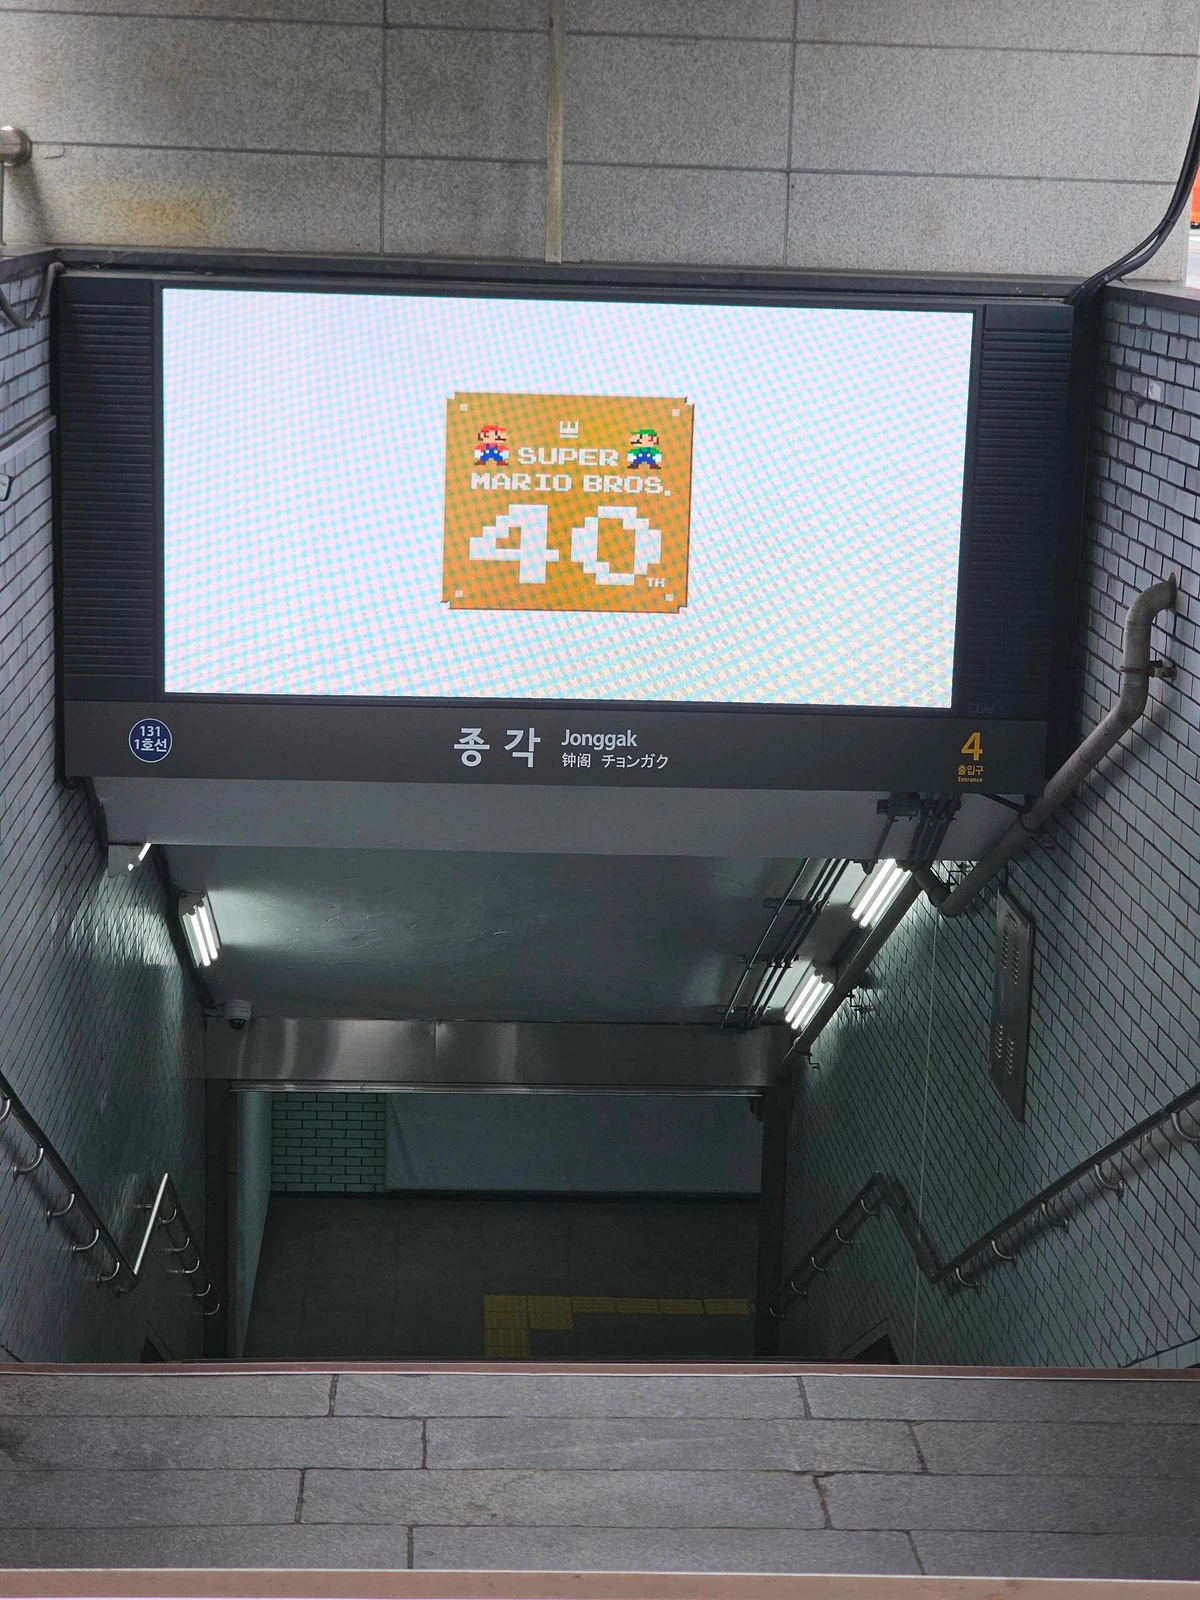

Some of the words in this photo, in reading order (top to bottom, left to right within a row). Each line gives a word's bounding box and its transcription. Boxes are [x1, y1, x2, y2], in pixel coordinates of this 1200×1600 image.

[518, 447, 619, 466] SUPER
[471, 473, 572, 491] MARIO
[583, 475, 671, 496] BROS.
[469, 504, 662, 586] 40
[140, 725, 161, 737] 131
[561, 729, 638, 750] Jonggak
[134, 738, 167, 752] 1호선
[961, 732, 984, 761] 4
[561, 752, 591, 768] 钟阁
[601, 753, 669, 769] チョンガク
[958, 764, 984, 776] 출입구
